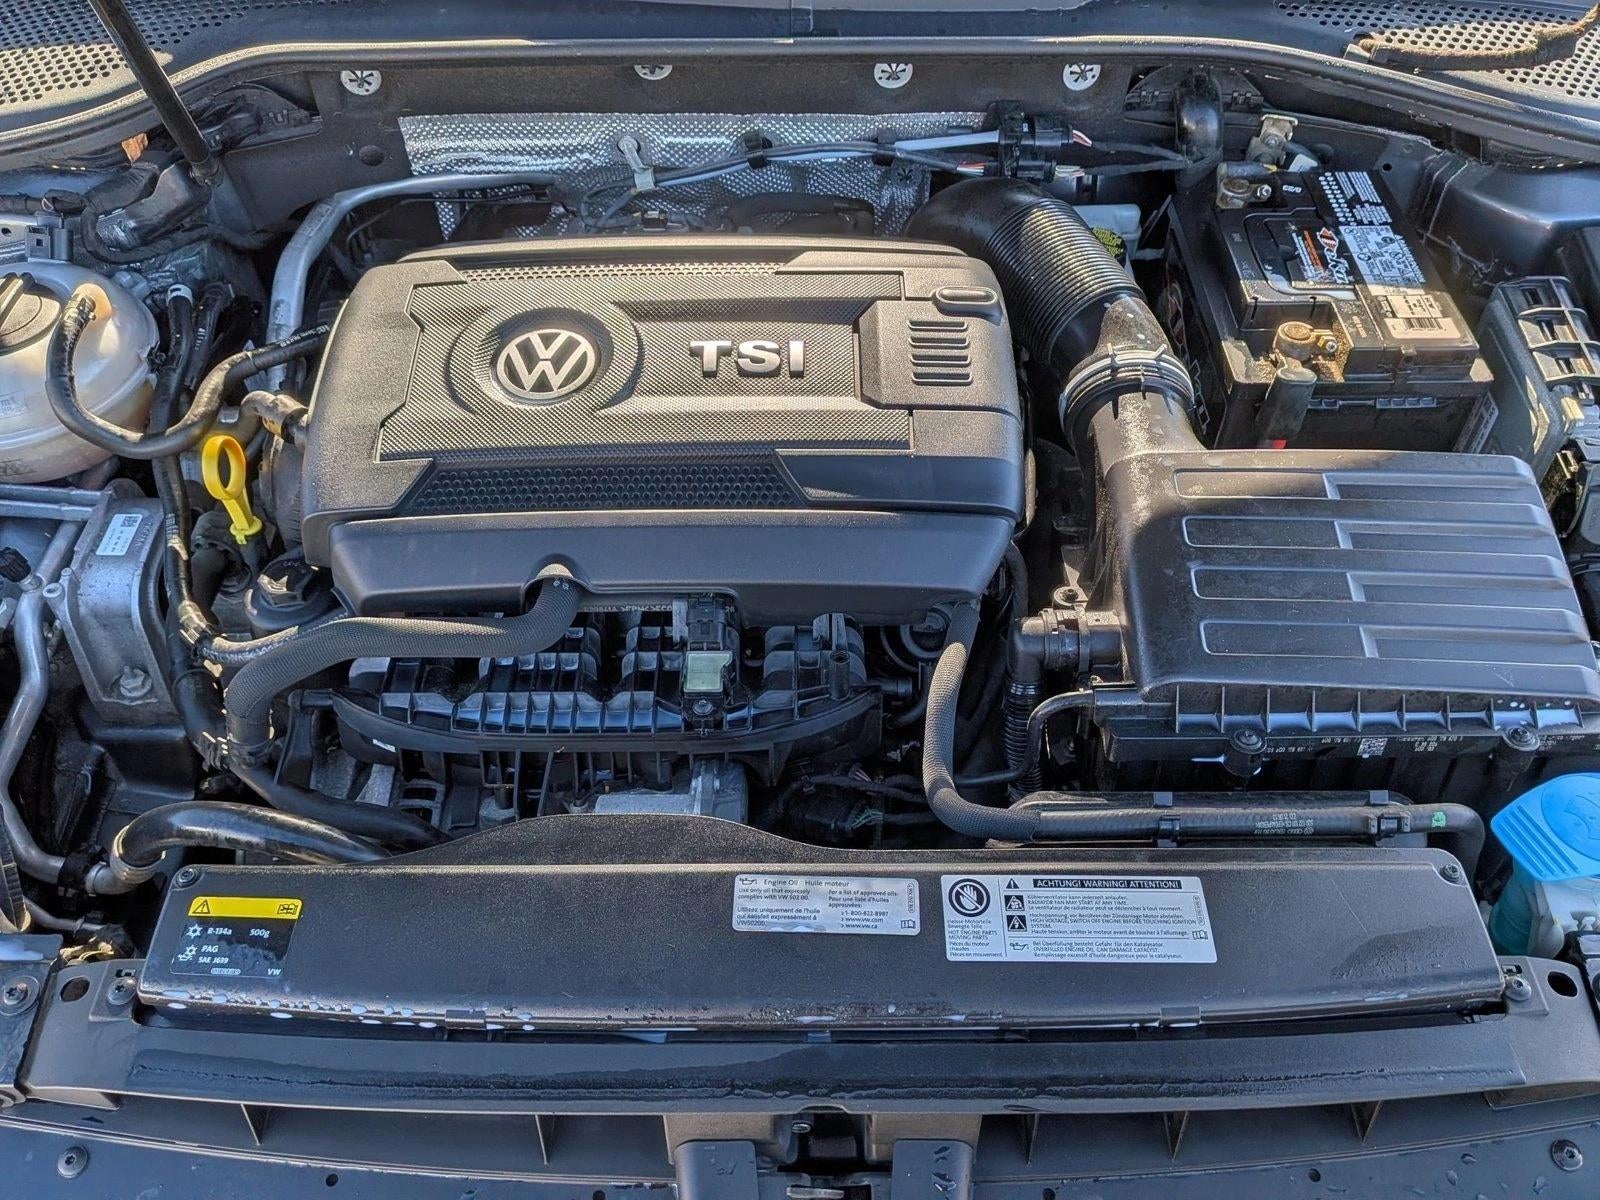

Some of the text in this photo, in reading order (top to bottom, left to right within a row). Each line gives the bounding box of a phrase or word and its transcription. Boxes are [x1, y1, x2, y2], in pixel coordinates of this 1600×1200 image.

[690, 340, 805, 377] TSI
[1083, 880, 1127, 888] WARNING!
[207, 927, 270, 938] R-134a 500g
[201, 945, 219, 953] PAG
[198, 956, 211, 964] SAE
[267, 968, 281, 976] VW
